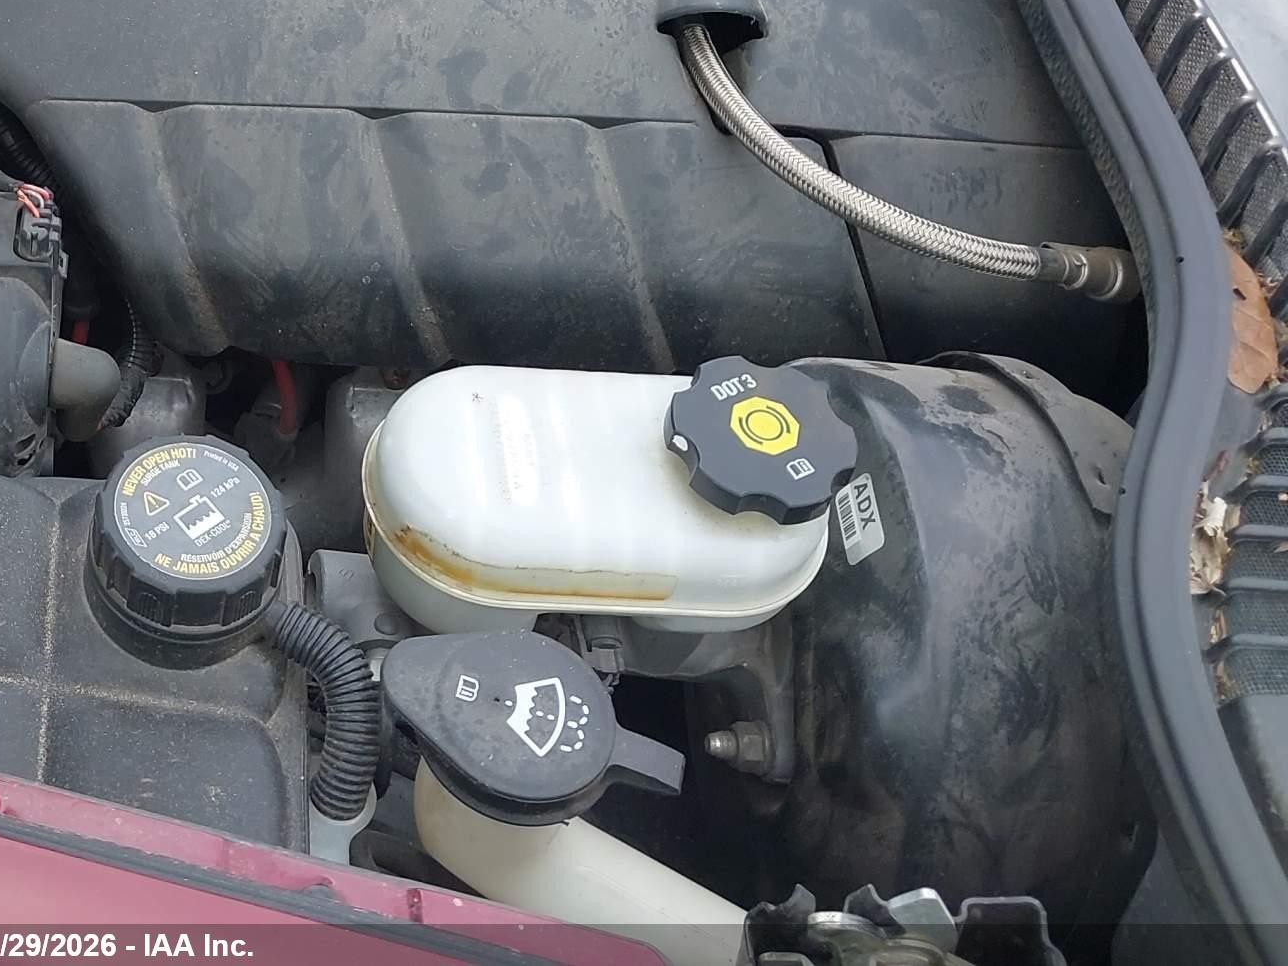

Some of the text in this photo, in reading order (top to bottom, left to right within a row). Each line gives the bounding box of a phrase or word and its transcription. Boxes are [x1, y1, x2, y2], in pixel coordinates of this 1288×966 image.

[710, 374, 757, 401] DOT 3
[122, 447, 196, 496] NEVER OPEN HOT!
[140, 459, 181, 486] SURGE TANK
[203, 450, 223, 462] Printed
[228, 460, 240, 472] USA
[210, 477, 241, 498] 124 kPa
[854, 482, 877, 531] ADX
[144, 529, 157, 541] 18
[154, 521, 170, 535] PSI
[154, 553, 172, 568] NE
[172, 560, 220, 574] JAMAIS
[219, 539, 257, 570] OUVRIR
[248, 491, 265, 531] CHAUD!
